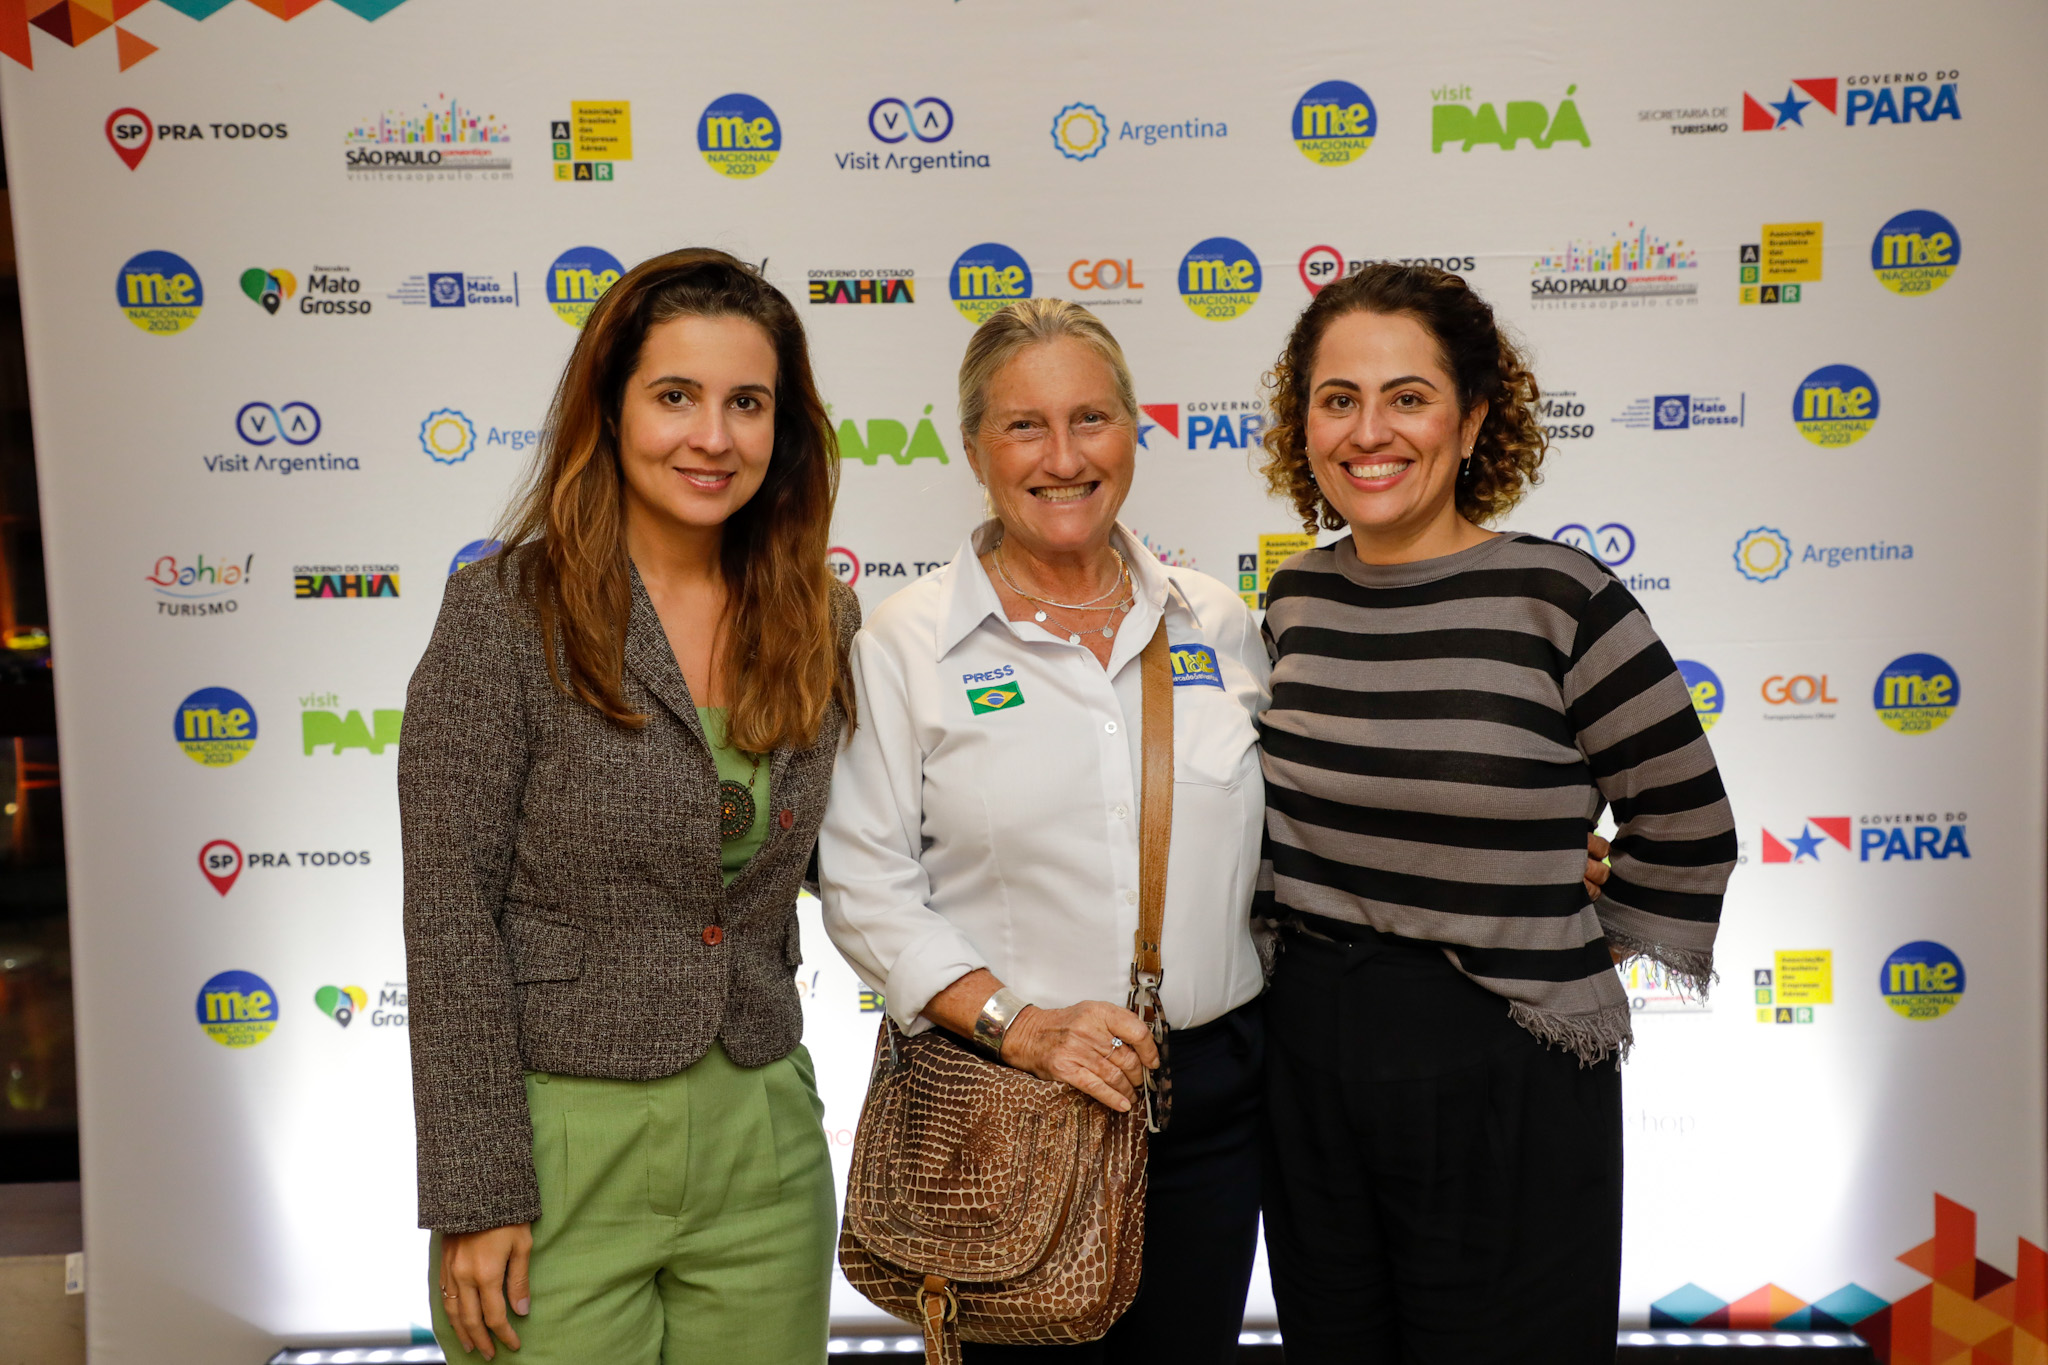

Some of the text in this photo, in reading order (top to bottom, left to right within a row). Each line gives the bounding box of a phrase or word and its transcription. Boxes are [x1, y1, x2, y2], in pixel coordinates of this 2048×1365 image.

[1847, 69, 1959, 86] GOVERNO DO
[1431, 84, 1472, 101] visit
[1432, 83, 1592, 153] PARÁ
[1638, 107, 1728, 122] SECRETARIA DE
[116, 123, 288, 140] SP PRA TODOS
[1119, 117, 1228, 146] Argentina
[1671, 123, 1729, 136] TURISMO
[1302, 139, 1367, 150] NACIONAL
[346, 147, 382, 165] SÃO
[386, 150, 441, 165] PAULO
[708, 153, 772, 163] NACIONAL
[835, 151, 990, 173] Visit Argentina
[1319, 151, 1350, 163] 2023
[726, 163, 757, 175] 2023
[808, 269, 914, 278] GOVERNO DO ESTADO
[1068, 259, 1144, 291] GOL
[1309, 262, 1335, 276] SP
[1881, 267, 1950, 281] NACIONAL
[308, 275, 360, 293] Mato
[467, 281, 500, 292] Mato
[1531, 275, 1567, 294] SÃO
[1571, 277, 1627, 293] PAULO
[1899, 280, 1931, 293] 2023
[467, 294, 513, 304] Grosso
[809, 280, 915, 304] BAHIA
[300, 297, 371, 315] Grosso
[1189, 295, 1253, 305] NACIONAL
[129, 309, 195, 319] NACIONAL
[1206, 306, 1237, 317] 2023
[148, 319, 179, 331] 2023
[1187, 401, 1262, 412] GOVERNO
[1692, 403, 1726, 413] Mato
[1692, 415, 1738, 425] Grosso
[1802, 421, 1869, 433] NACIONAL
[1820, 433, 1851, 444] 2023
[204, 453, 360, 474] Visit Argentina
[1802, 540, 1914, 568] Argentina
[145, 553, 255, 587] Bahia!
[293, 564, 399, 574] GOVERNO DO ESTADO
[865, 562, 907, 577] PRA
[295, 575, 400, 599] BAHIA
[157, 600, 238, 617] TURISMO
[963, 664, 1014, 685] PRESS
[1762, 674, 1838, 705] GOL
[299, 692, 339, 708] visit
[1882, 708, 1949, 720] NACIONAL
[1900, 720, 1932, 732] 2023
[185, 740, 248, 752] NACIONAL
[204, 752, 233, 765] 2023
[1860, 811, 1967, 825] GOVERNO DO
[209, 850, 371, 869] SP PRA TODOS
[1890, 994, 1955, 1006] NACIONAL
[1908, 1006, 1939, 1018] 2023
